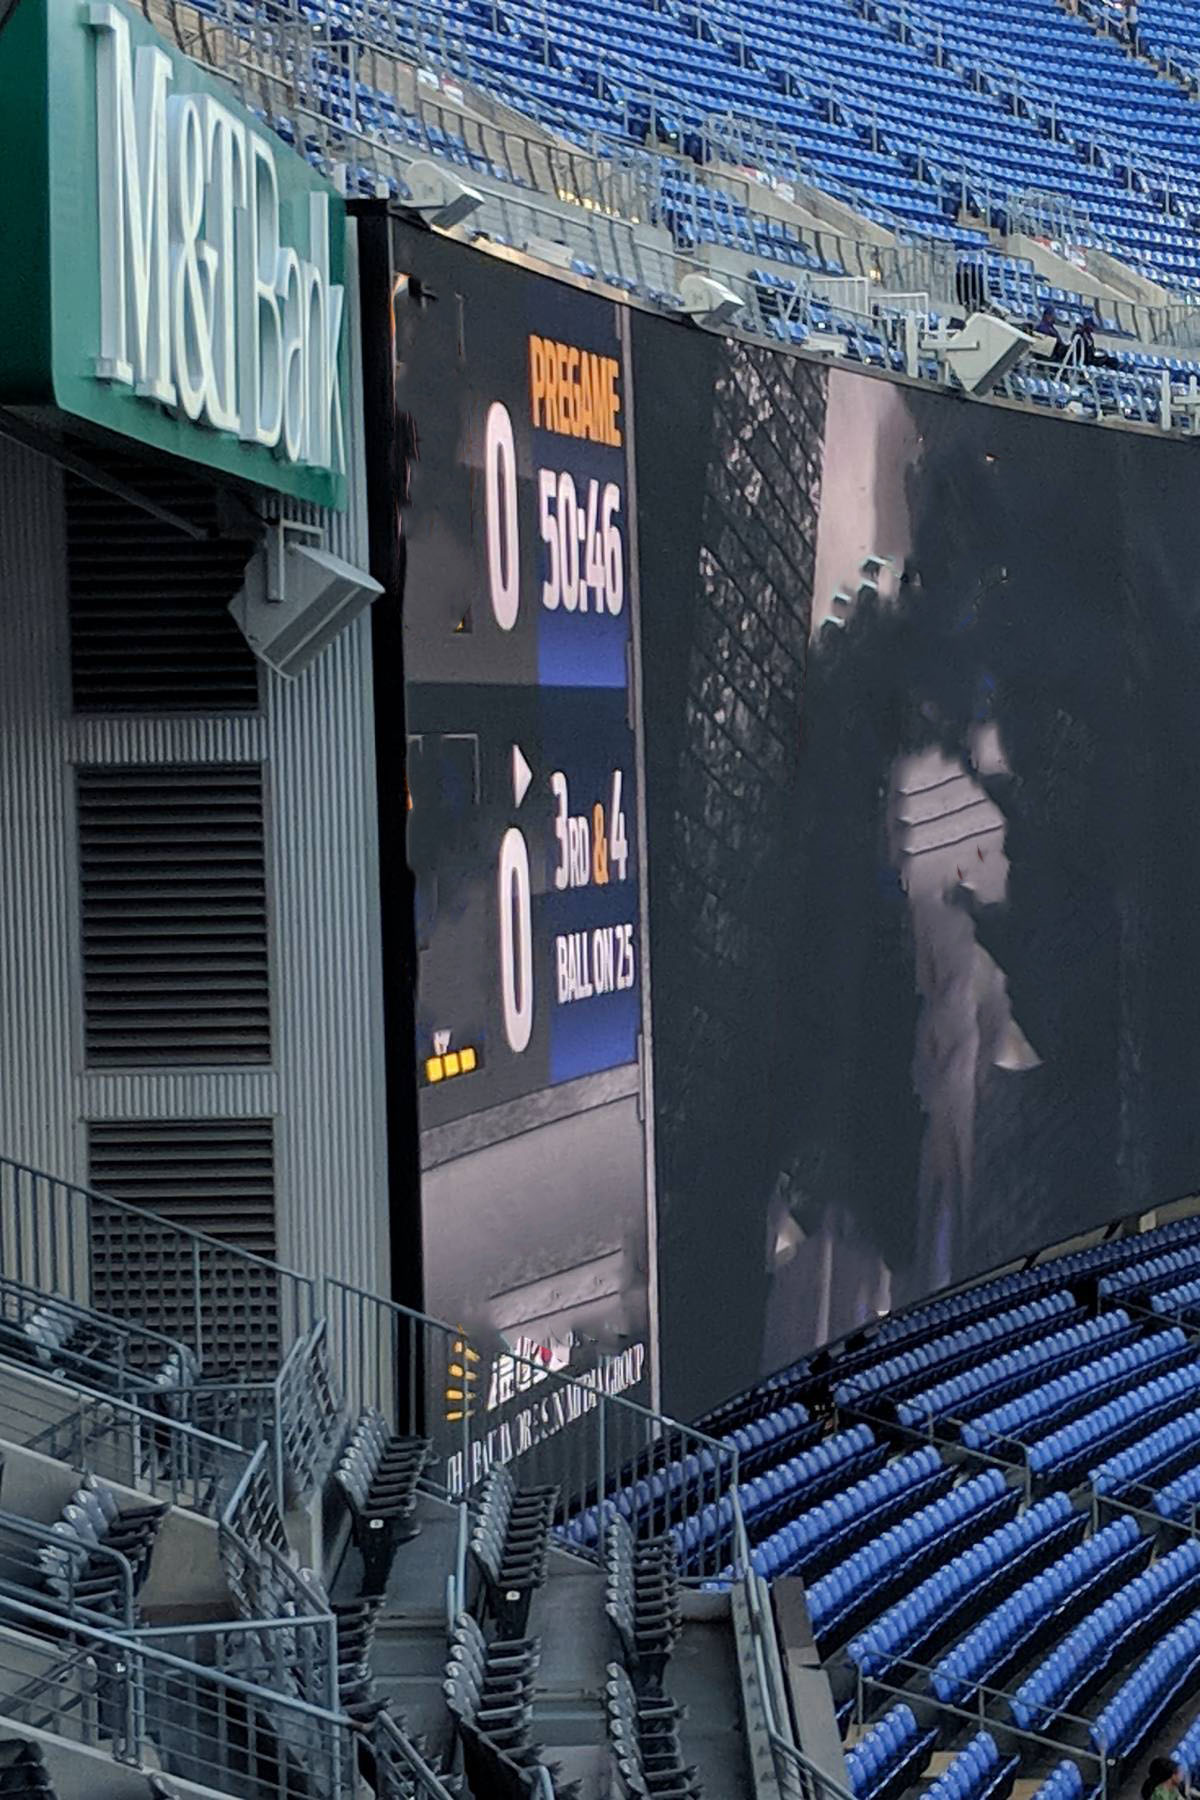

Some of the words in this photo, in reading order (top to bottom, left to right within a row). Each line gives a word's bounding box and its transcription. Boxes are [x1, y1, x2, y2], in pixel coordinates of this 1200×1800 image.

[89, 3, 247, 433] M&T
[235, 130, 346, 475] Bank
[529, 334, 622, 447] PREGAME
[486, 401, 519, 631] 0
[538, 468, 623, 616] 50:46
[551, 771, 589, 890] 3RD
[593, 803, 609, 885] &
[611, 769, 628, 881] 4
[499, 827, 532, 1051] 0
[556, 932, 593, 1004] BALL
[593, 928, 614, 994] ON
[615, 923, 634, 990] 25
